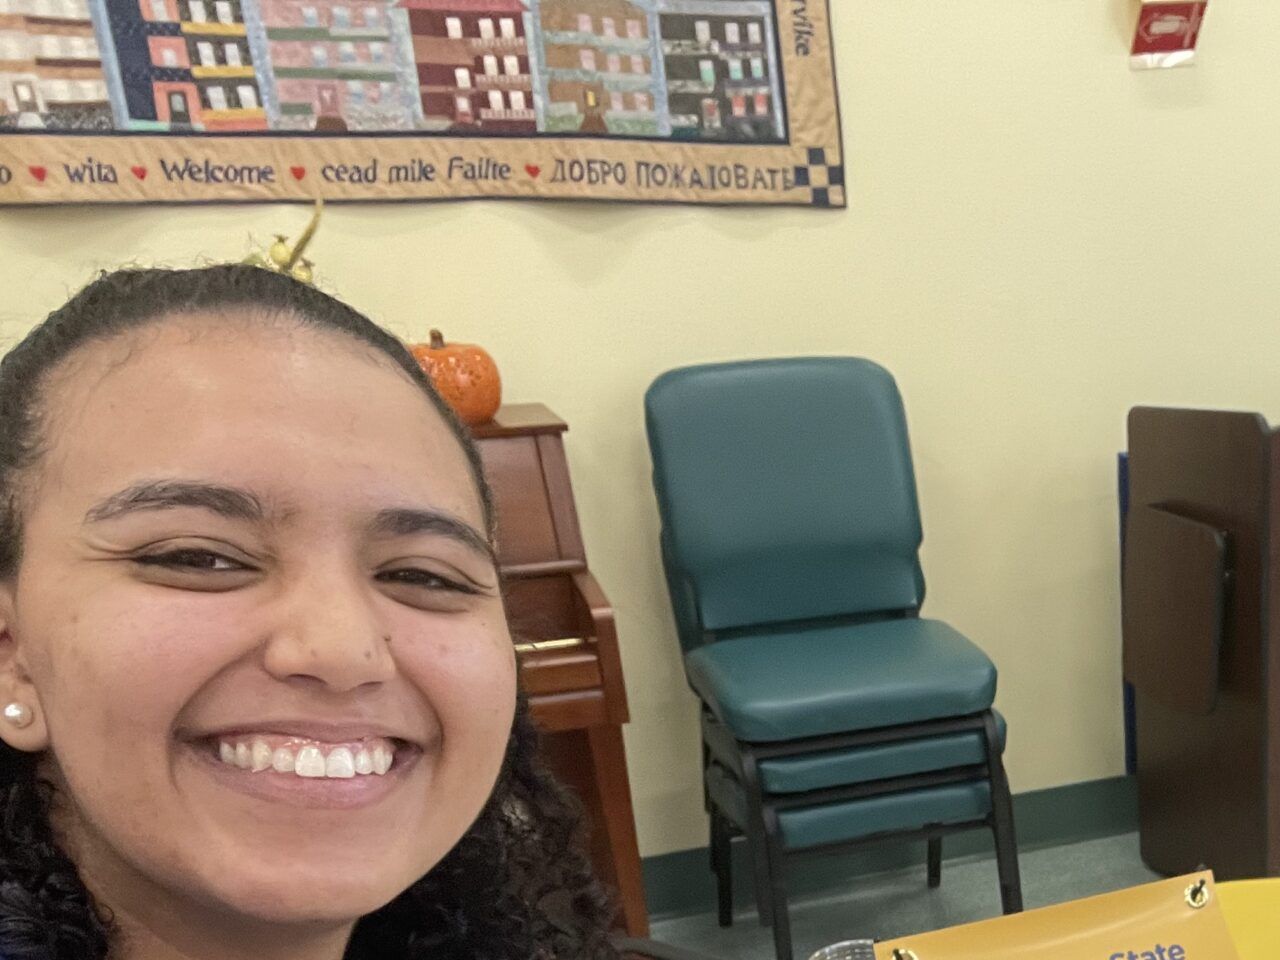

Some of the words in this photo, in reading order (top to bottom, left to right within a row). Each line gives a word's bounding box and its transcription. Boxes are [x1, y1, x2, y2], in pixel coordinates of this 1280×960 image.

[160, 157, 276, 186] Welcome
[321, 159, 378, 185] cead
[388, 156, 437, 183] mile
[550, 158, 628, 186] ДОБРО
